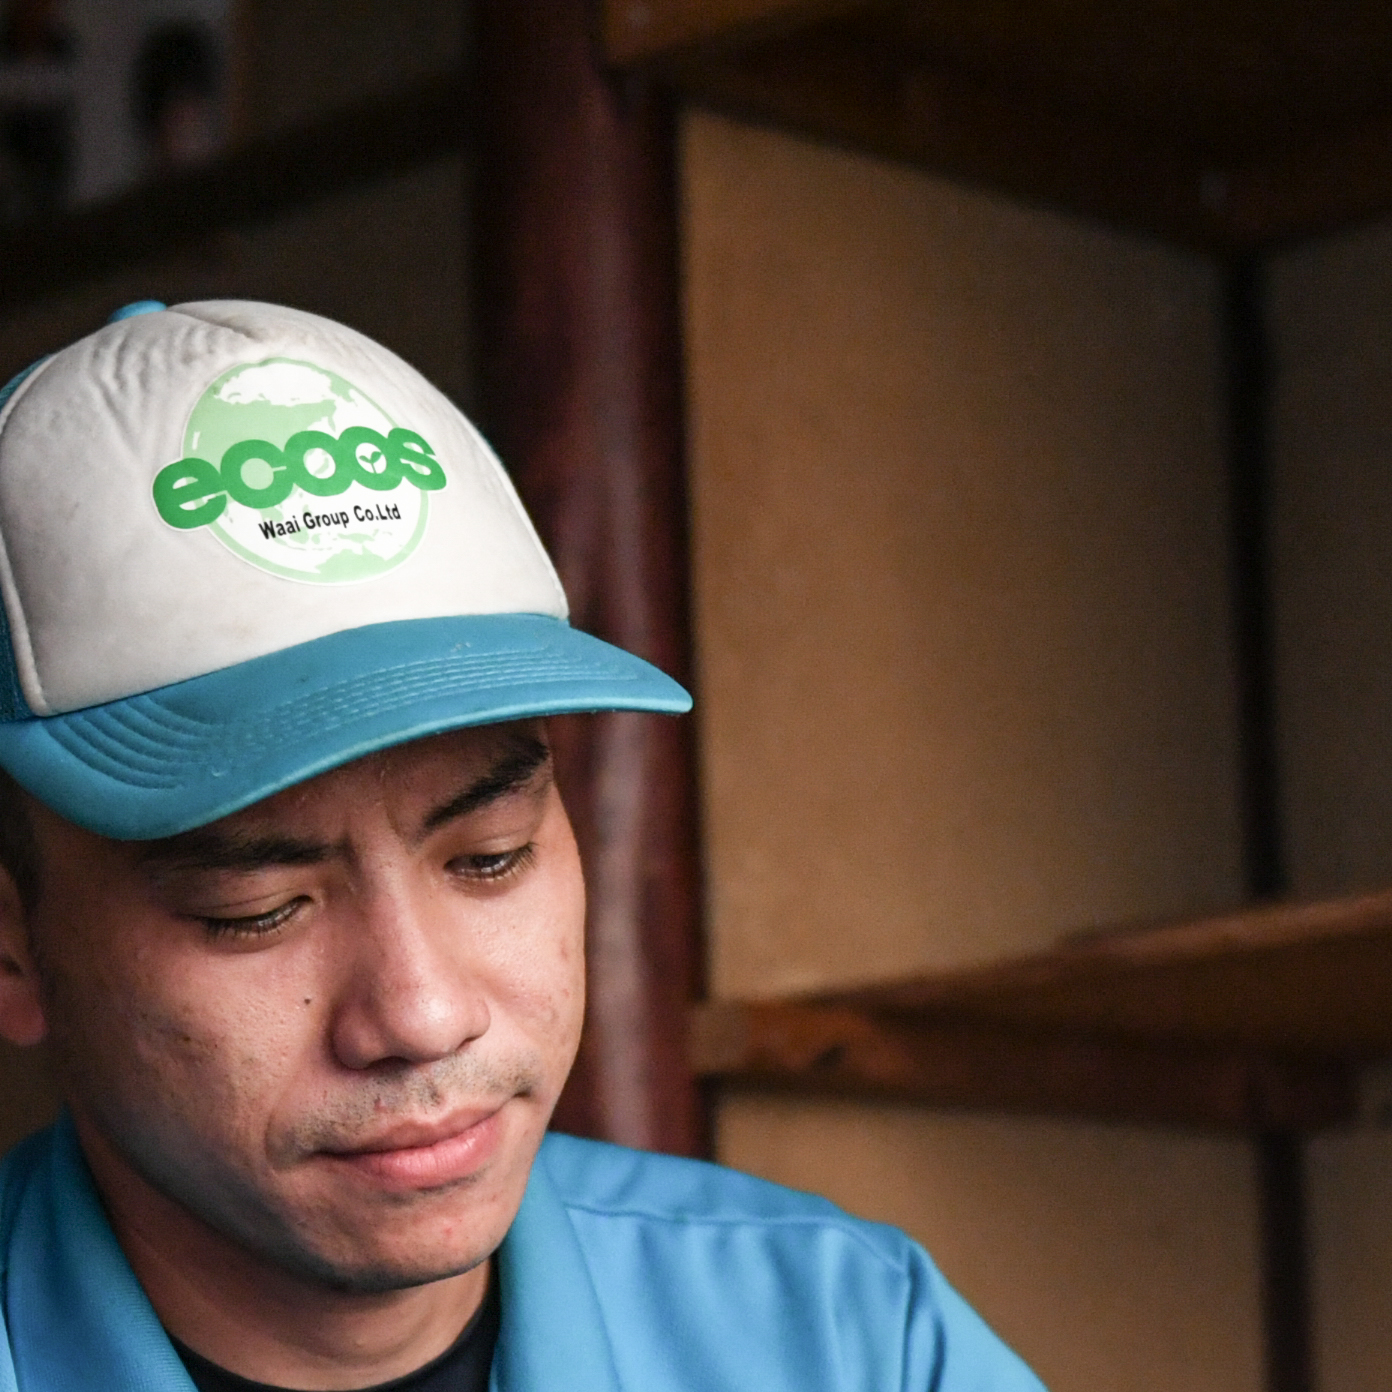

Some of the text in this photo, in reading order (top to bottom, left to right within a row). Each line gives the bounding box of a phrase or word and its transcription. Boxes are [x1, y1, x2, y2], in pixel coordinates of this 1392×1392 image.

[153, 426, 446, 529] ecoos
[258, 503, 402, 541] Waai Group Co.Ltd
